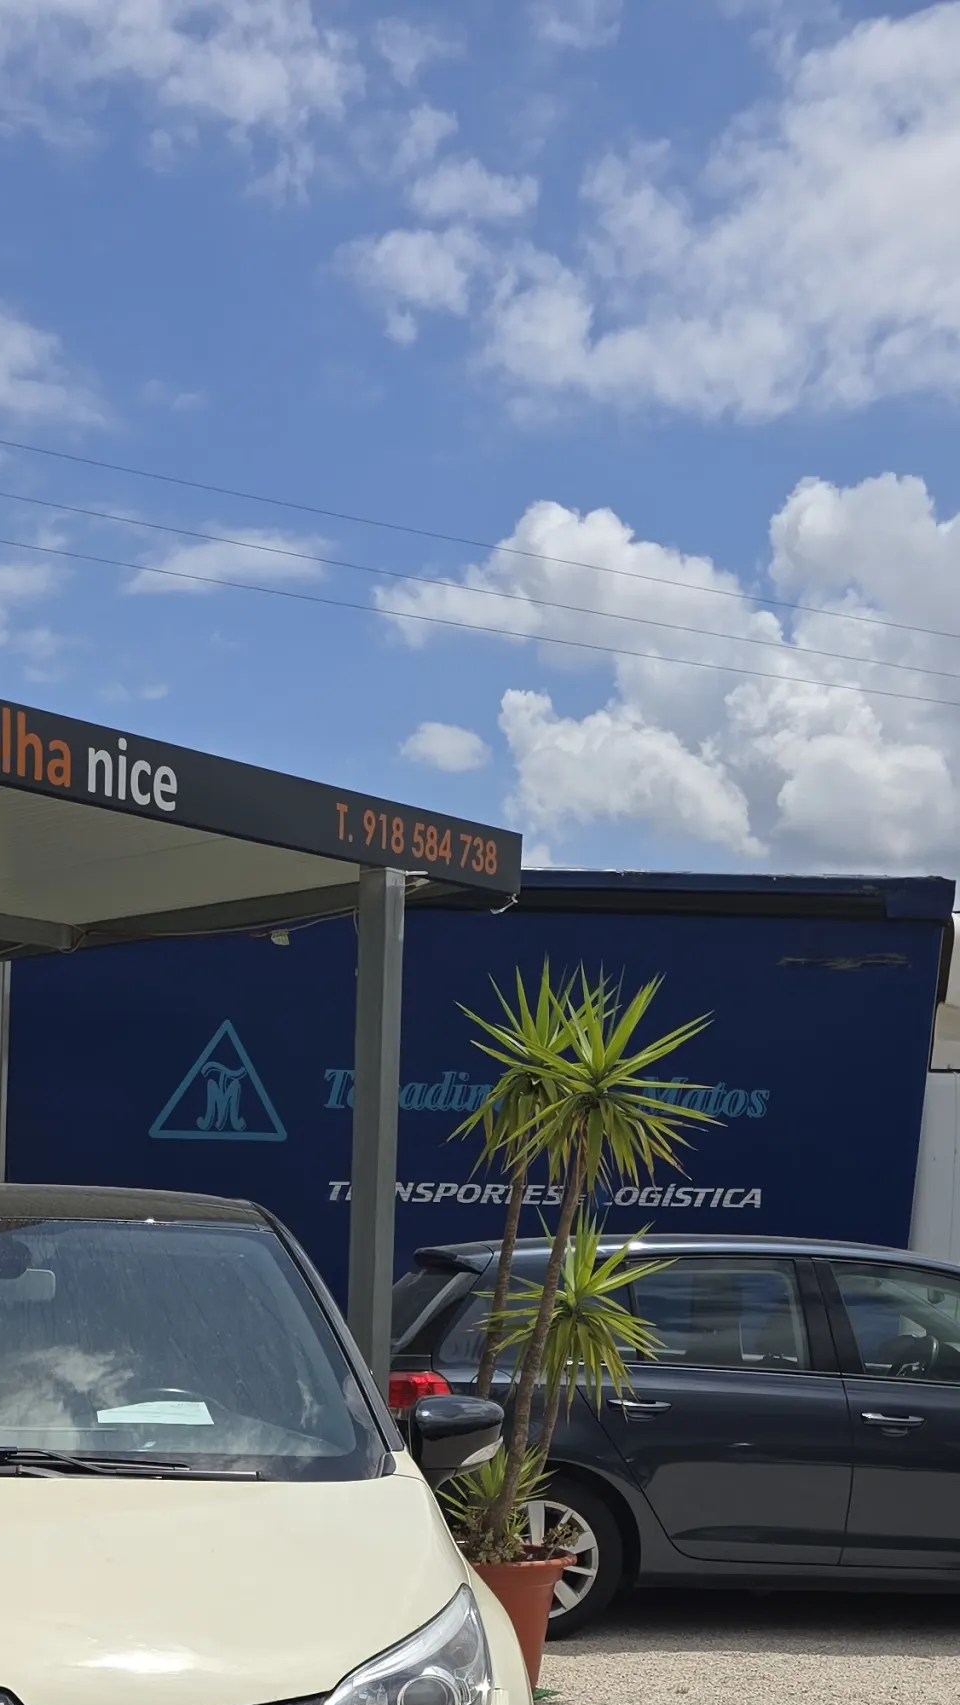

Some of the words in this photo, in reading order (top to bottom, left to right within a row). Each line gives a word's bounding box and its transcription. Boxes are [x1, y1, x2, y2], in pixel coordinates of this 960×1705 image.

[87, 738, 178, 812] nice
[336, 802, 354, 843] T.
[363, 809, 405, 855] 918
[411, 822, 453, 866] 584
[459, 833, 499, 876] 738
[638, 1076, 771, 1118] Matos
[328, 1181, 564, 1206] TNSPORTES
[600, 1183, 762, 1209] OGÍSTICA
